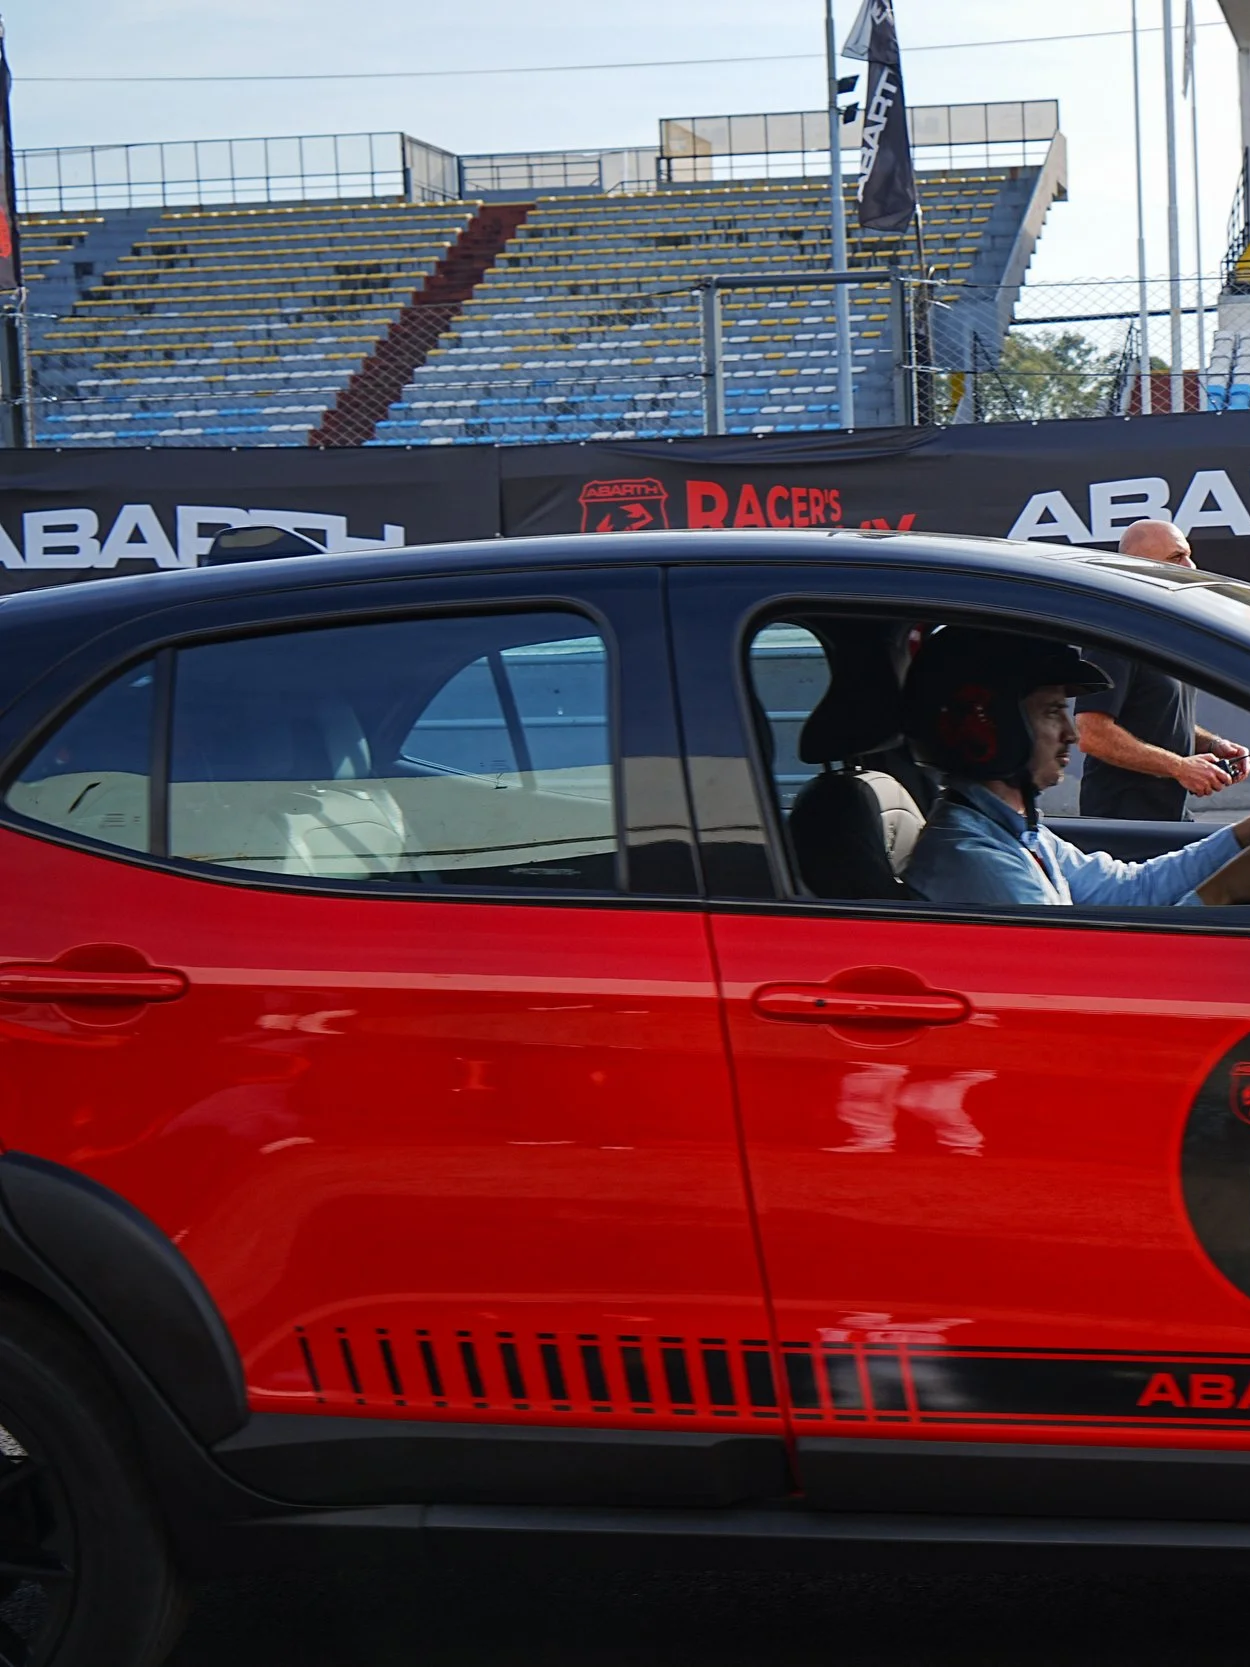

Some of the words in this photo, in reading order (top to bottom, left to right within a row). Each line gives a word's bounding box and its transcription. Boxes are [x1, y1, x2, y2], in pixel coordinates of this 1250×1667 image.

[857, 66, 898, 202] ABART
[586, 483, 659, 498] ABARTH
[686, 480, 842, 529] RACER'S
